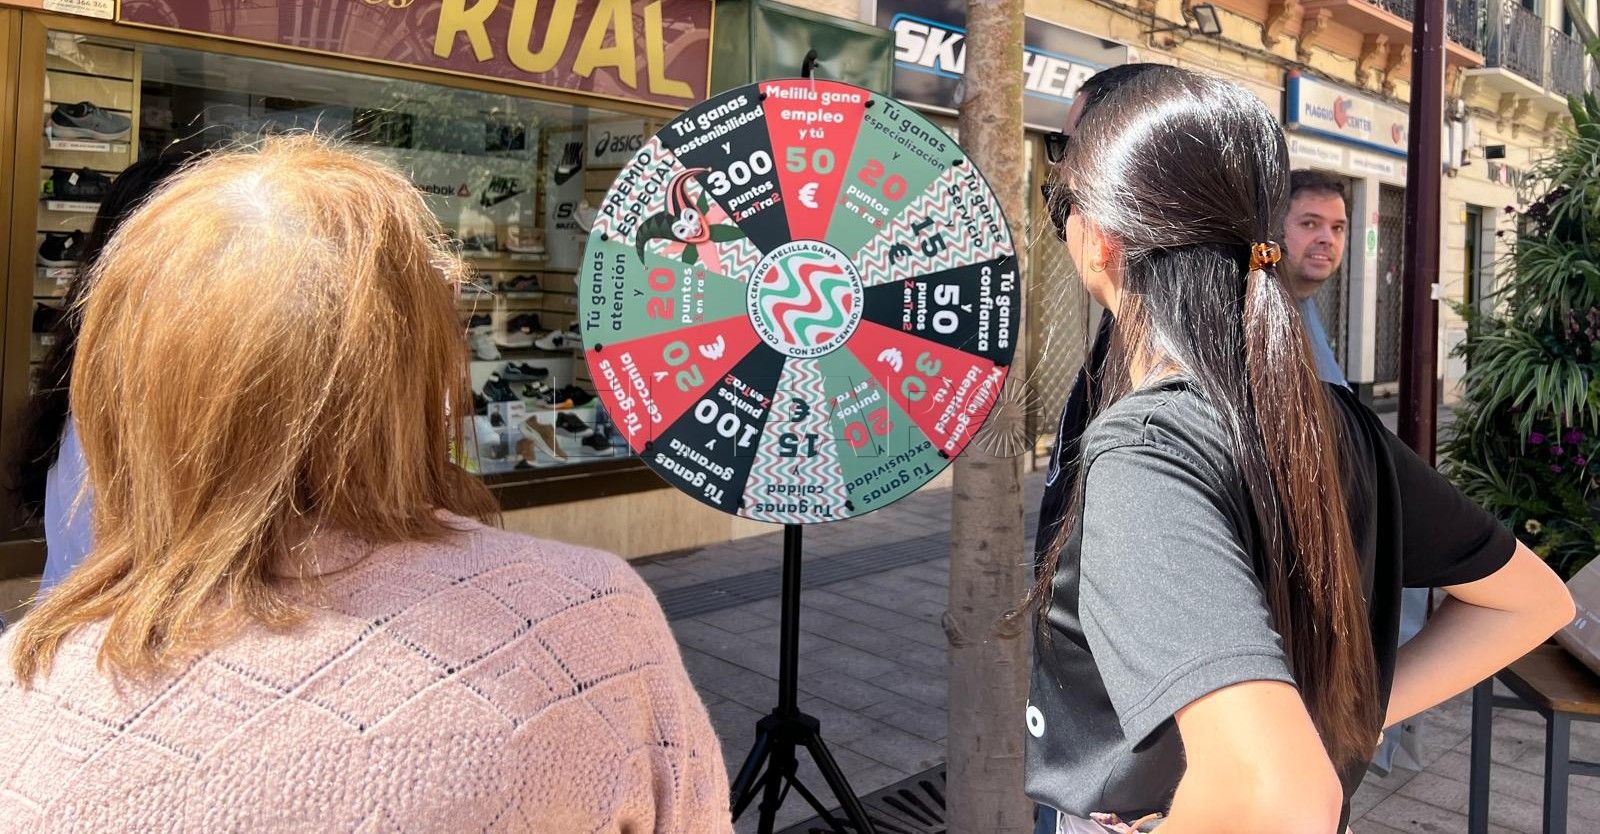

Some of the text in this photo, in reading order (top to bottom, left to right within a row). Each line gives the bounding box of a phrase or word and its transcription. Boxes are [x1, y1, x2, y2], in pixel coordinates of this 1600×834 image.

[433, 0, 695, 98] RUAL
[672, 95, 748, 136] Tú ganas
[766, 85, 861, 105] Melilla gana
[674, 105, 764, 157] sostenibilidad
[781, 108, 844, 125] empleo
[799, 128, 824, 140] y tú
[882, 102, 947, 153] Tú ganas
[721, 142, 731, 155] y
[786, 146, 835, 174] 50
[892, 151, 901, 161] y
[603, 152, 651, 218] PREMIO
[707, 150, 772, 195] 300
[857, 159, 908, 201] 20
[616, 159, 676, 237] ESPECIAL
[728, 181, 773, 211] puntos
[798, 182, 819, 208] €
[847, 185, 890, 216] puntos
[945, 220, 954, 228] y
[948, 184, 983, 248] Servicio
[971, 195, 1003, 243] ganas
[770, 244, 809, 262] MELILLA
[811, 244, 837, 260] GANA
[888, 242, 913, 265] €
[911, 216, 947, 258] 15
[586, 251, 606, 331] Tú ganas
[610, 254, 626, 331] atención
[633, 289, 645, 297] y
[646, 267, 676, 321] 20
[681, 267, 693, 323] puntos
[789, 347, 808, 355] CON
[810, 343, 835, 355] ZONA
[845, 264, 861, 294] GANAS
[916, 282, 927, 330] puntos
[932, 284, 960, 334] 50
[961, 304, 972, 313] y
[978, 266, 994, 351] confianza
[995, 271, 1015, 349] Tú ganas
[751, 301, 765, 327] ZONA
[698, 334, 725, 360] €
[762, 327, 779, 345] CON
[653, 371, 669, 382] y
[662, 341, 704, 392] 20
[877, 347, 903, 373] €
[901, 352, 942, 401] 30
[599, 359, 642, 436] Tú ganas
[620, 352, 662, 423] cercanía
[934, 365, 983, 434] identidad
[942, 376, 953, 388] y
[695, 399, 758, 448] 100
[718, 388, 764, 419] puntos
[791, 398, 811, 422] €
[836, 390, 881, 419] puntos
[945, 366, 1003, 451] Melilla gana
[705, 439, 717, 451] y
[779, 433, 819, 458] 15
[843, 407, 894, 448] 20
[669, 438, 735, 481] garantía
[845, 441, 932, 494] exclusividad
[877, 444, 885, 455] y
[654, 453, 724, 505] Tú ganas
[767, 484, 824, 497] calidad
[792, 465, 799, 476] y
[862, 462, 934, 504] Tú ganas
[756, 500, 833, 517] Tú ganas
